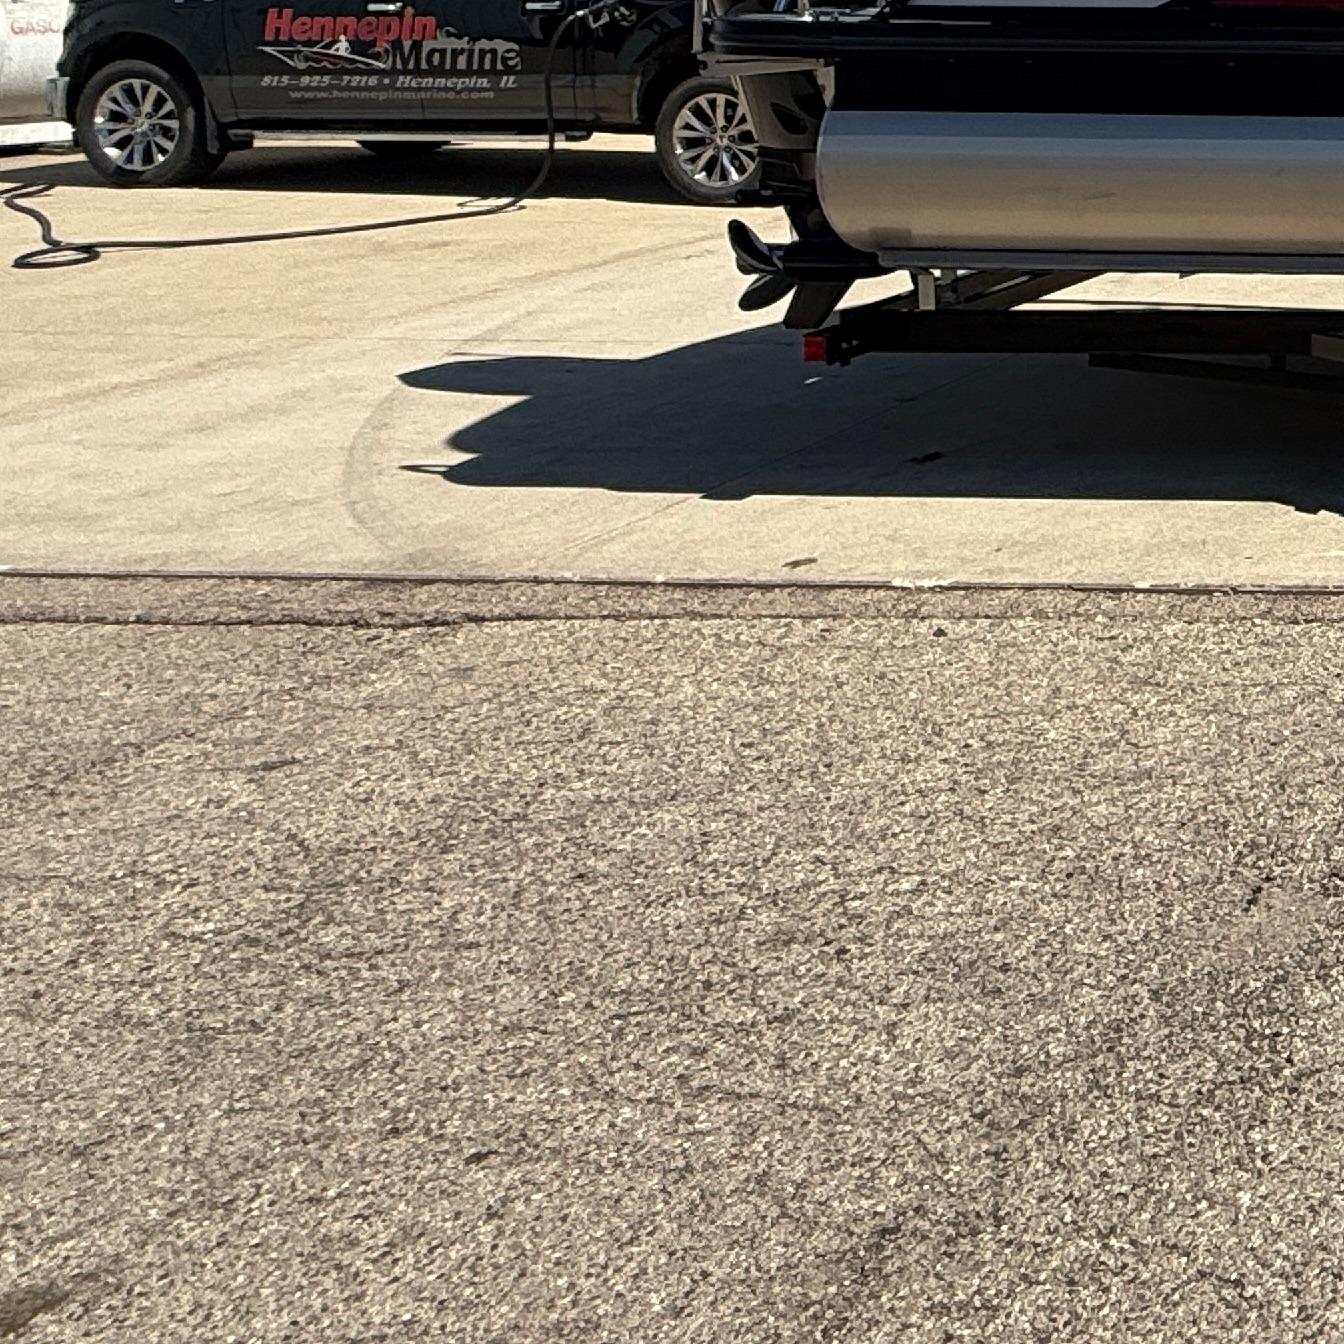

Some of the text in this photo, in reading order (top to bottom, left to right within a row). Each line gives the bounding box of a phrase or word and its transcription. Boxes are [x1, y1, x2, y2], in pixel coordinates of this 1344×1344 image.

[264, 6, 436, 48] Hennepin
[389, 37, 522, 71] Marine
[260, 74, 378, 88] 815-925-7216
[499, 75, 519, 88] IL
[289, 90, 495, 101] www.hennepinmarine.com
